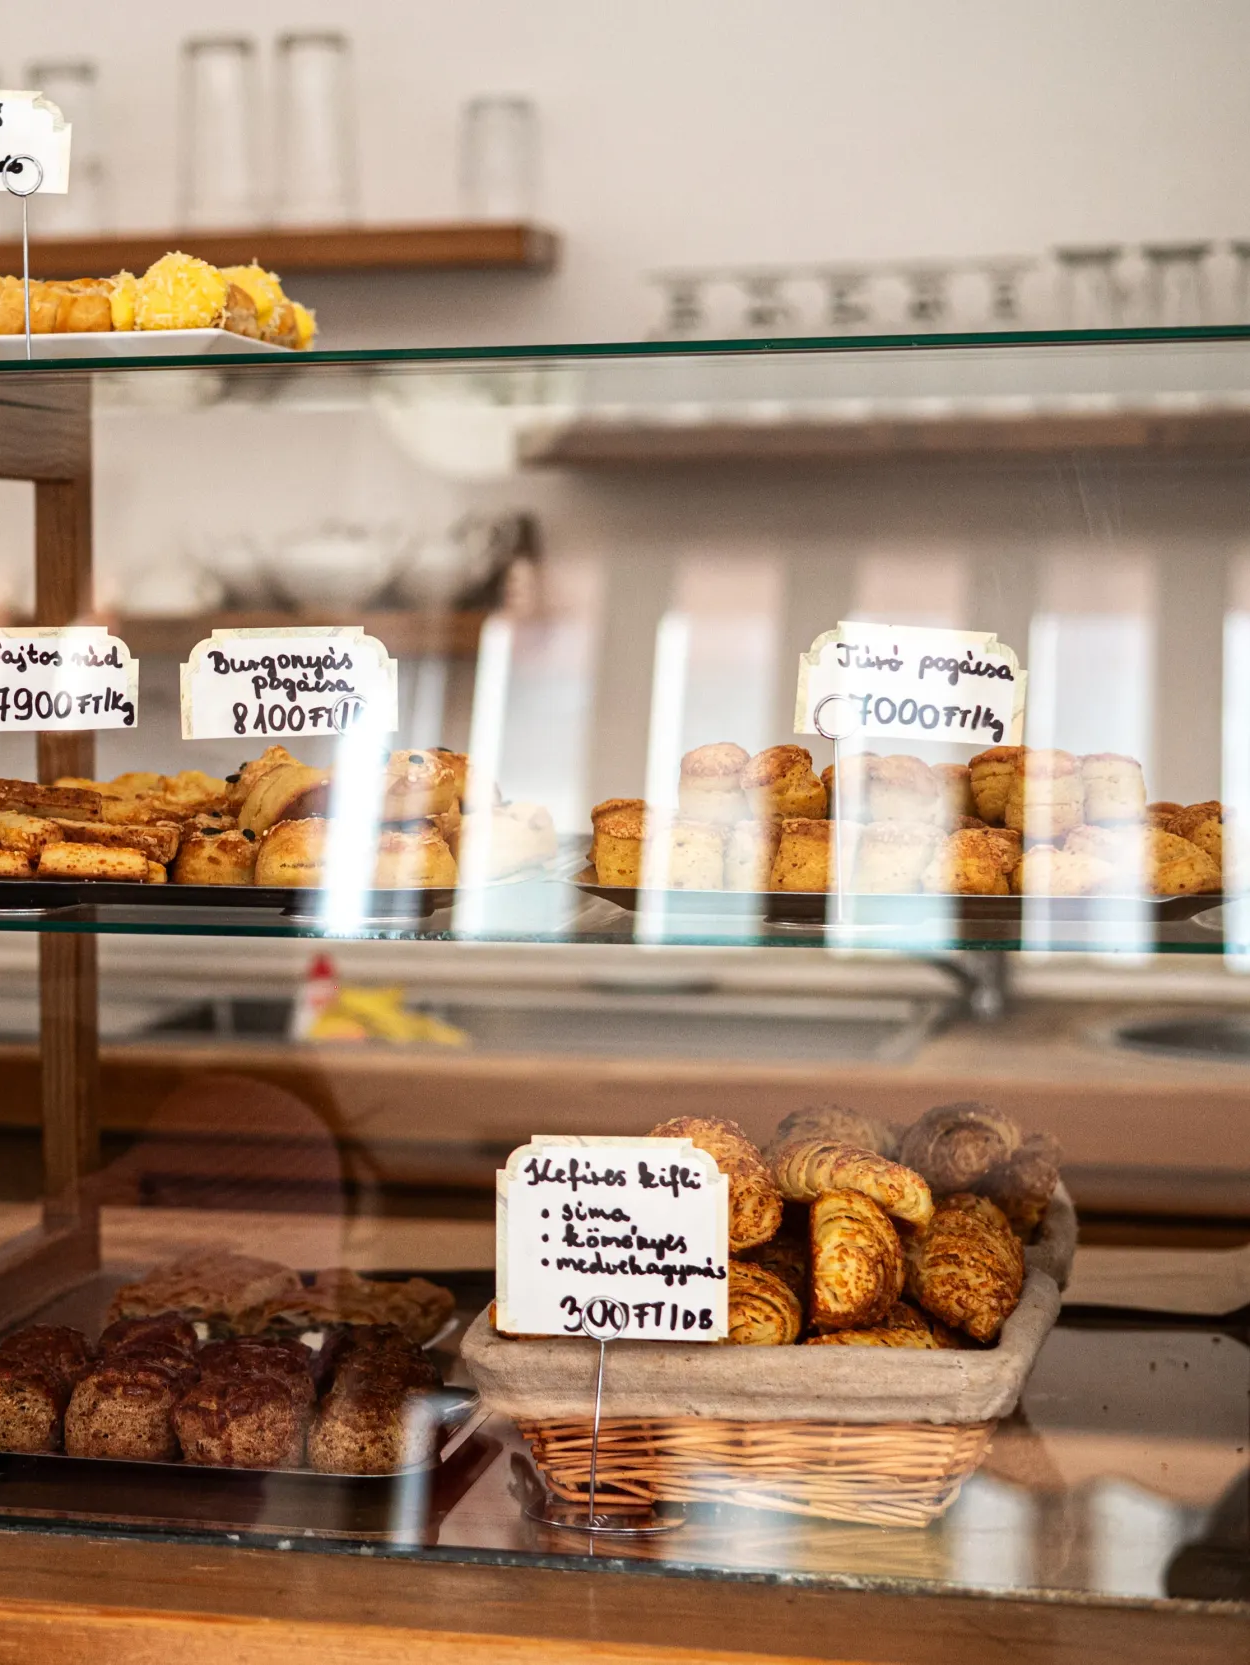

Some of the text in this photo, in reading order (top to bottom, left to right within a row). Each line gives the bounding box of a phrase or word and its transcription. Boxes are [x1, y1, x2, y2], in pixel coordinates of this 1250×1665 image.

[208, 647, 354, 680] Burgonyás
[917, 650, 1015, 686] pogácsa
[637, 1161, 702, 1198] kifli
[561, 1200, 631, 1222] sima
[556, 1251, 727, 1287] medvehagymás
